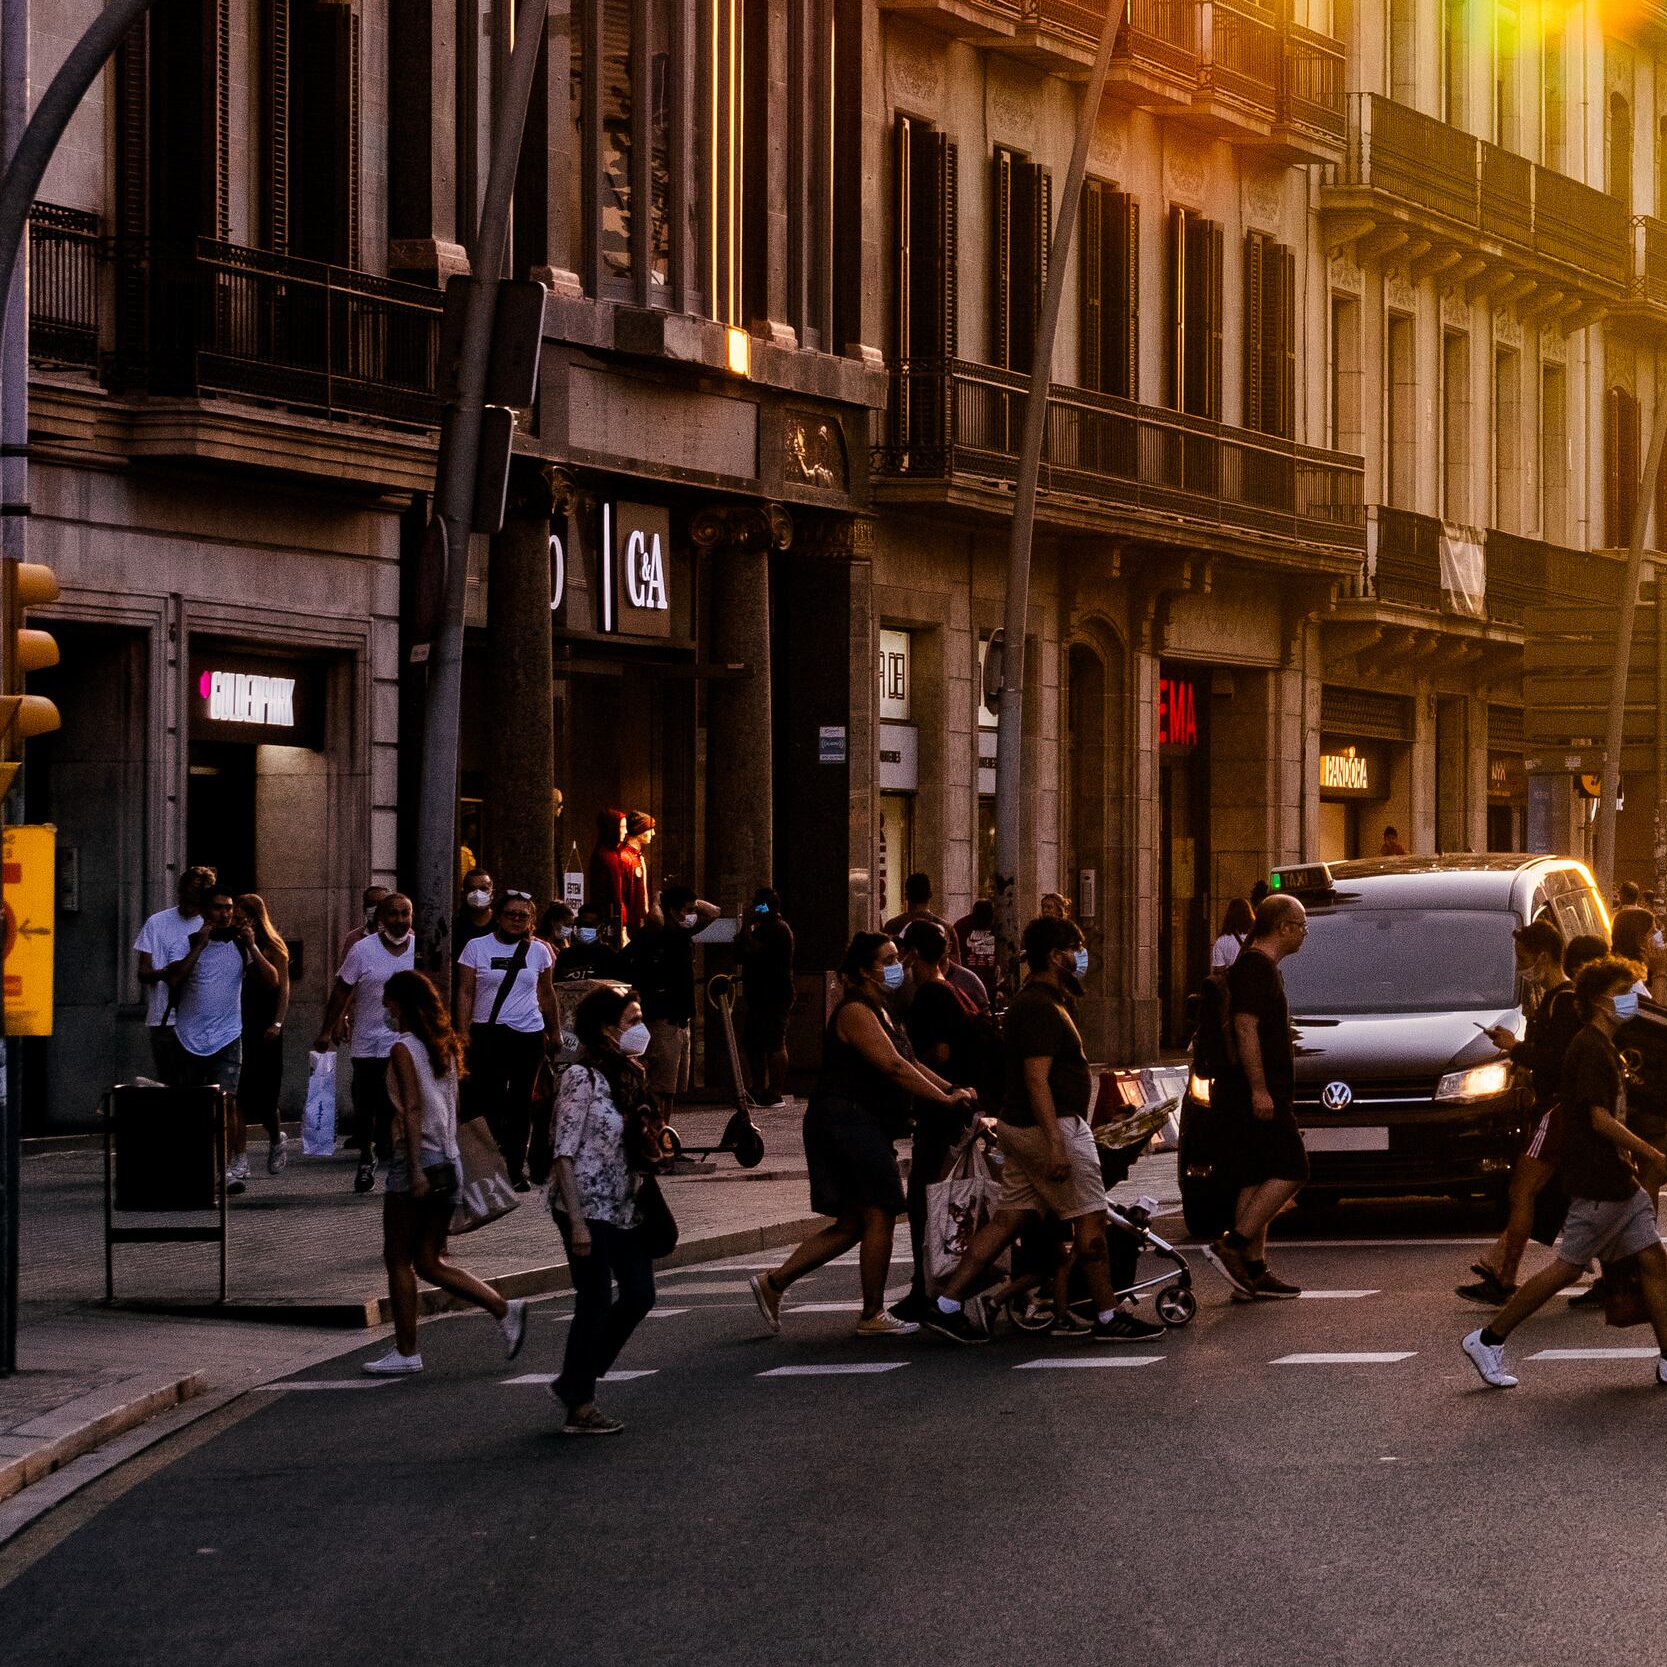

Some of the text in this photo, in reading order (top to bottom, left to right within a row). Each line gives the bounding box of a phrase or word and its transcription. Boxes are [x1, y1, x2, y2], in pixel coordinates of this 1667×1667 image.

[627, 530, 668, 609] C&A
[1324, 755, 1368, 789] PANDORA
[1282, 872, 1308, 888] TAXI
